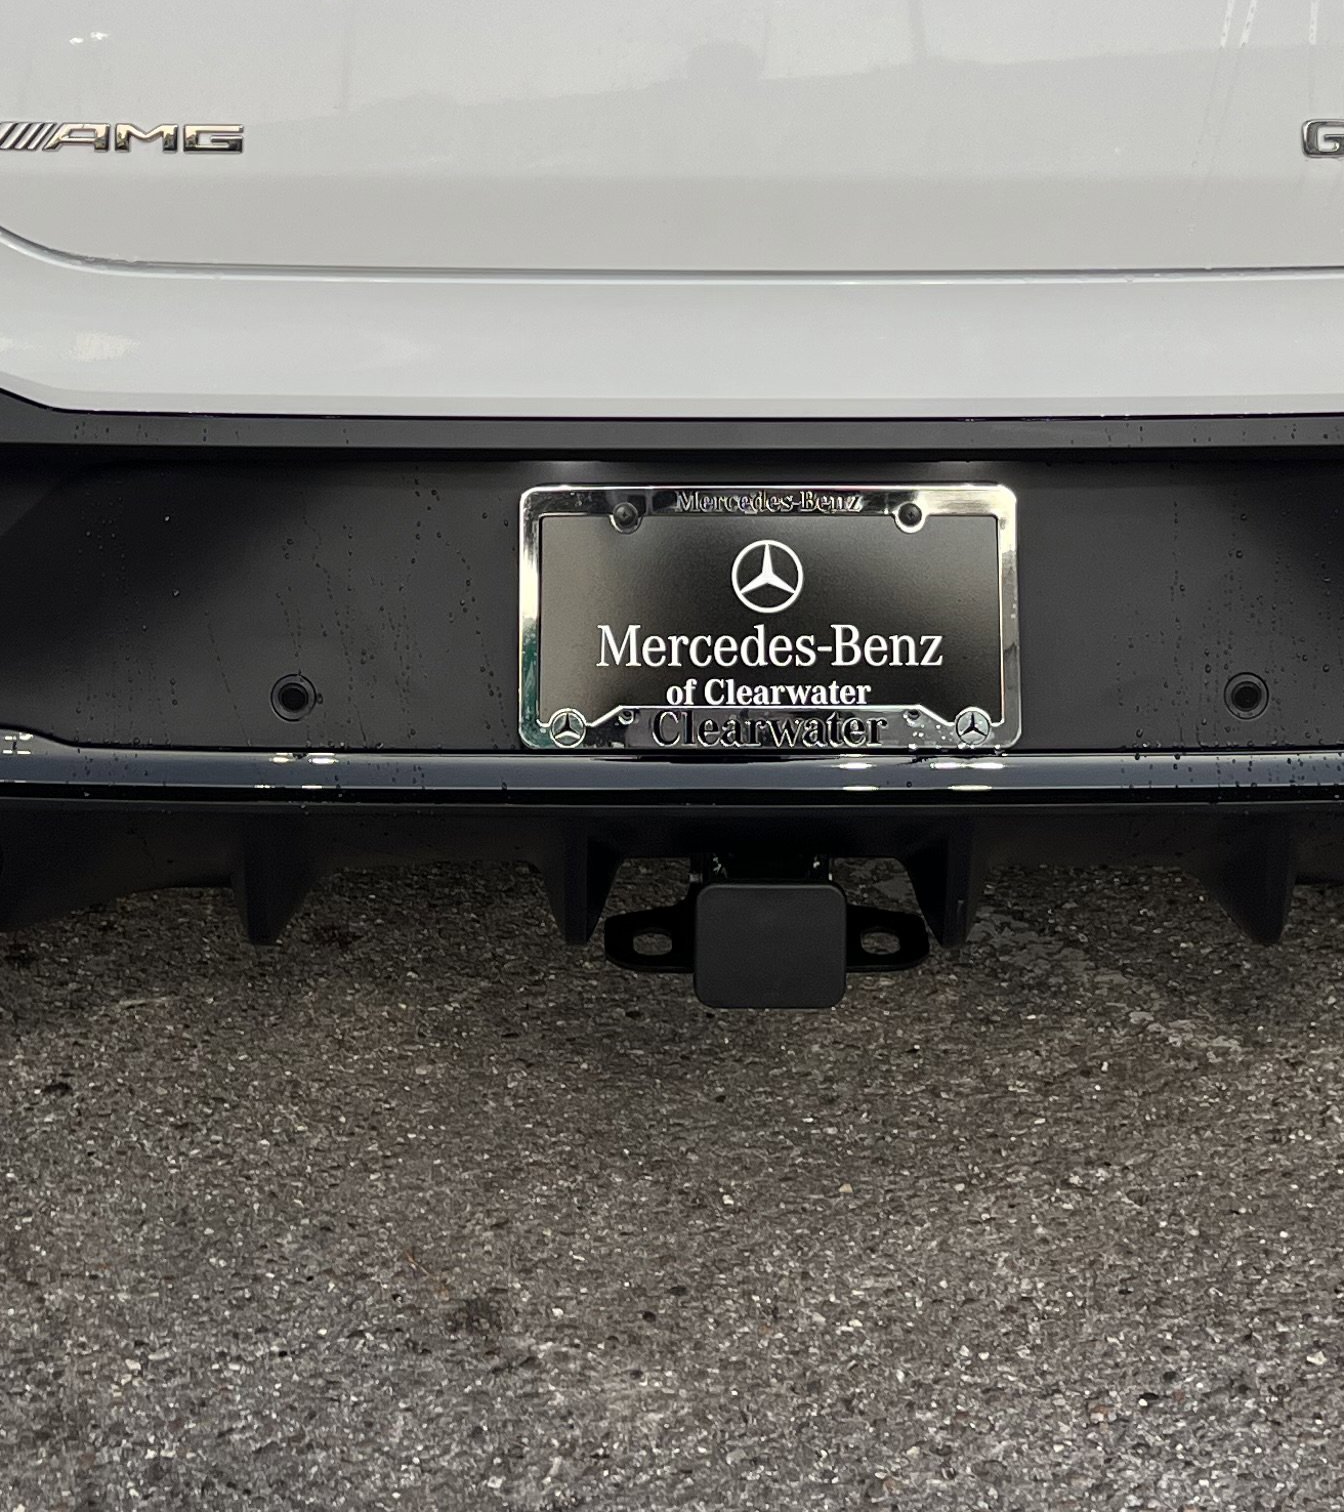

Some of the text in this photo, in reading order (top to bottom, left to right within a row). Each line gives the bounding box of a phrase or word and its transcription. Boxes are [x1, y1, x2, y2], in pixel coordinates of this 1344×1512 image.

[42, 122, 244, 153] AMG
[675, 490, 864, 514] Mercedes-Benz
[596, 624, 943, 667] Mercedes-Benz
[666, 678, 872, 705] of Clearwater
[652, 710, 888, 748] Clearwater
